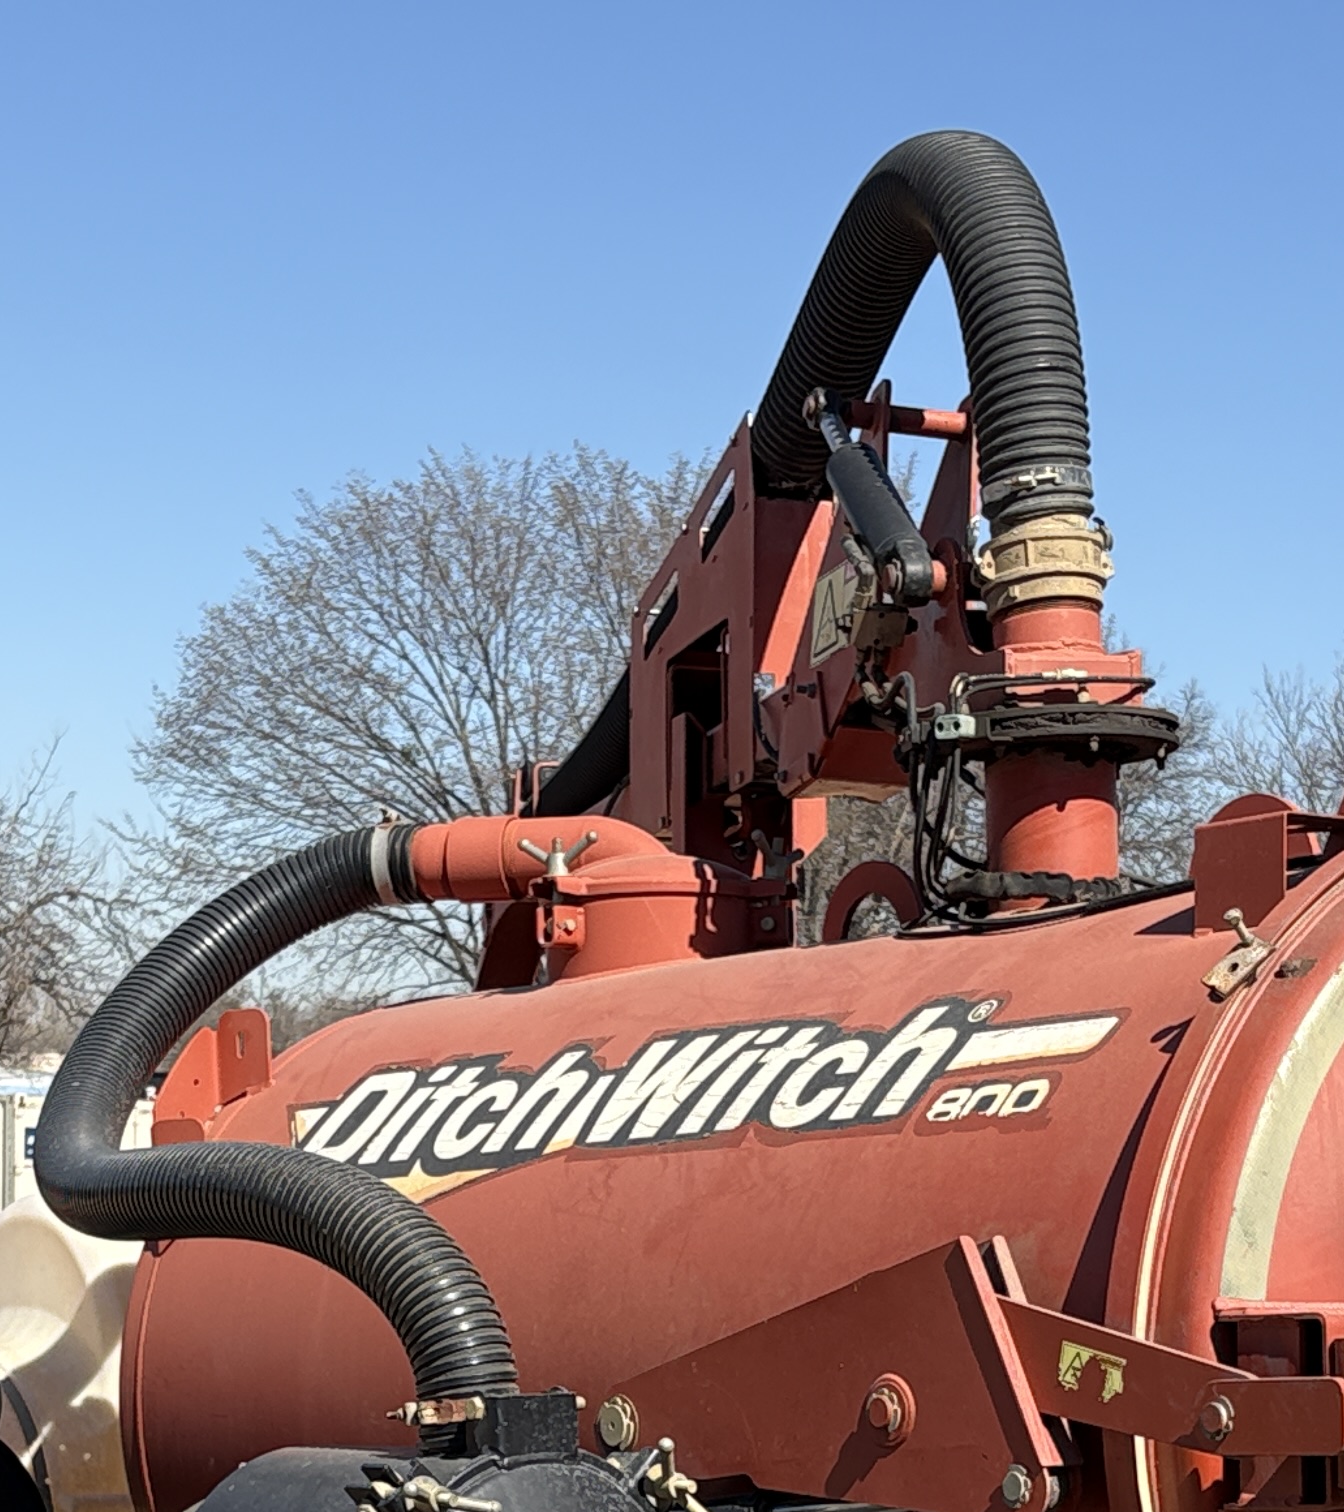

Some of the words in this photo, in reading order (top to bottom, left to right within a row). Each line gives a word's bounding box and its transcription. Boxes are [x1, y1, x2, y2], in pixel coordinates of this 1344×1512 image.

[302, 1049, 592, 1165] Ditch
[584, 1006, 956, 1143] Witch
[926, 1078, 1050, 1123] 800
